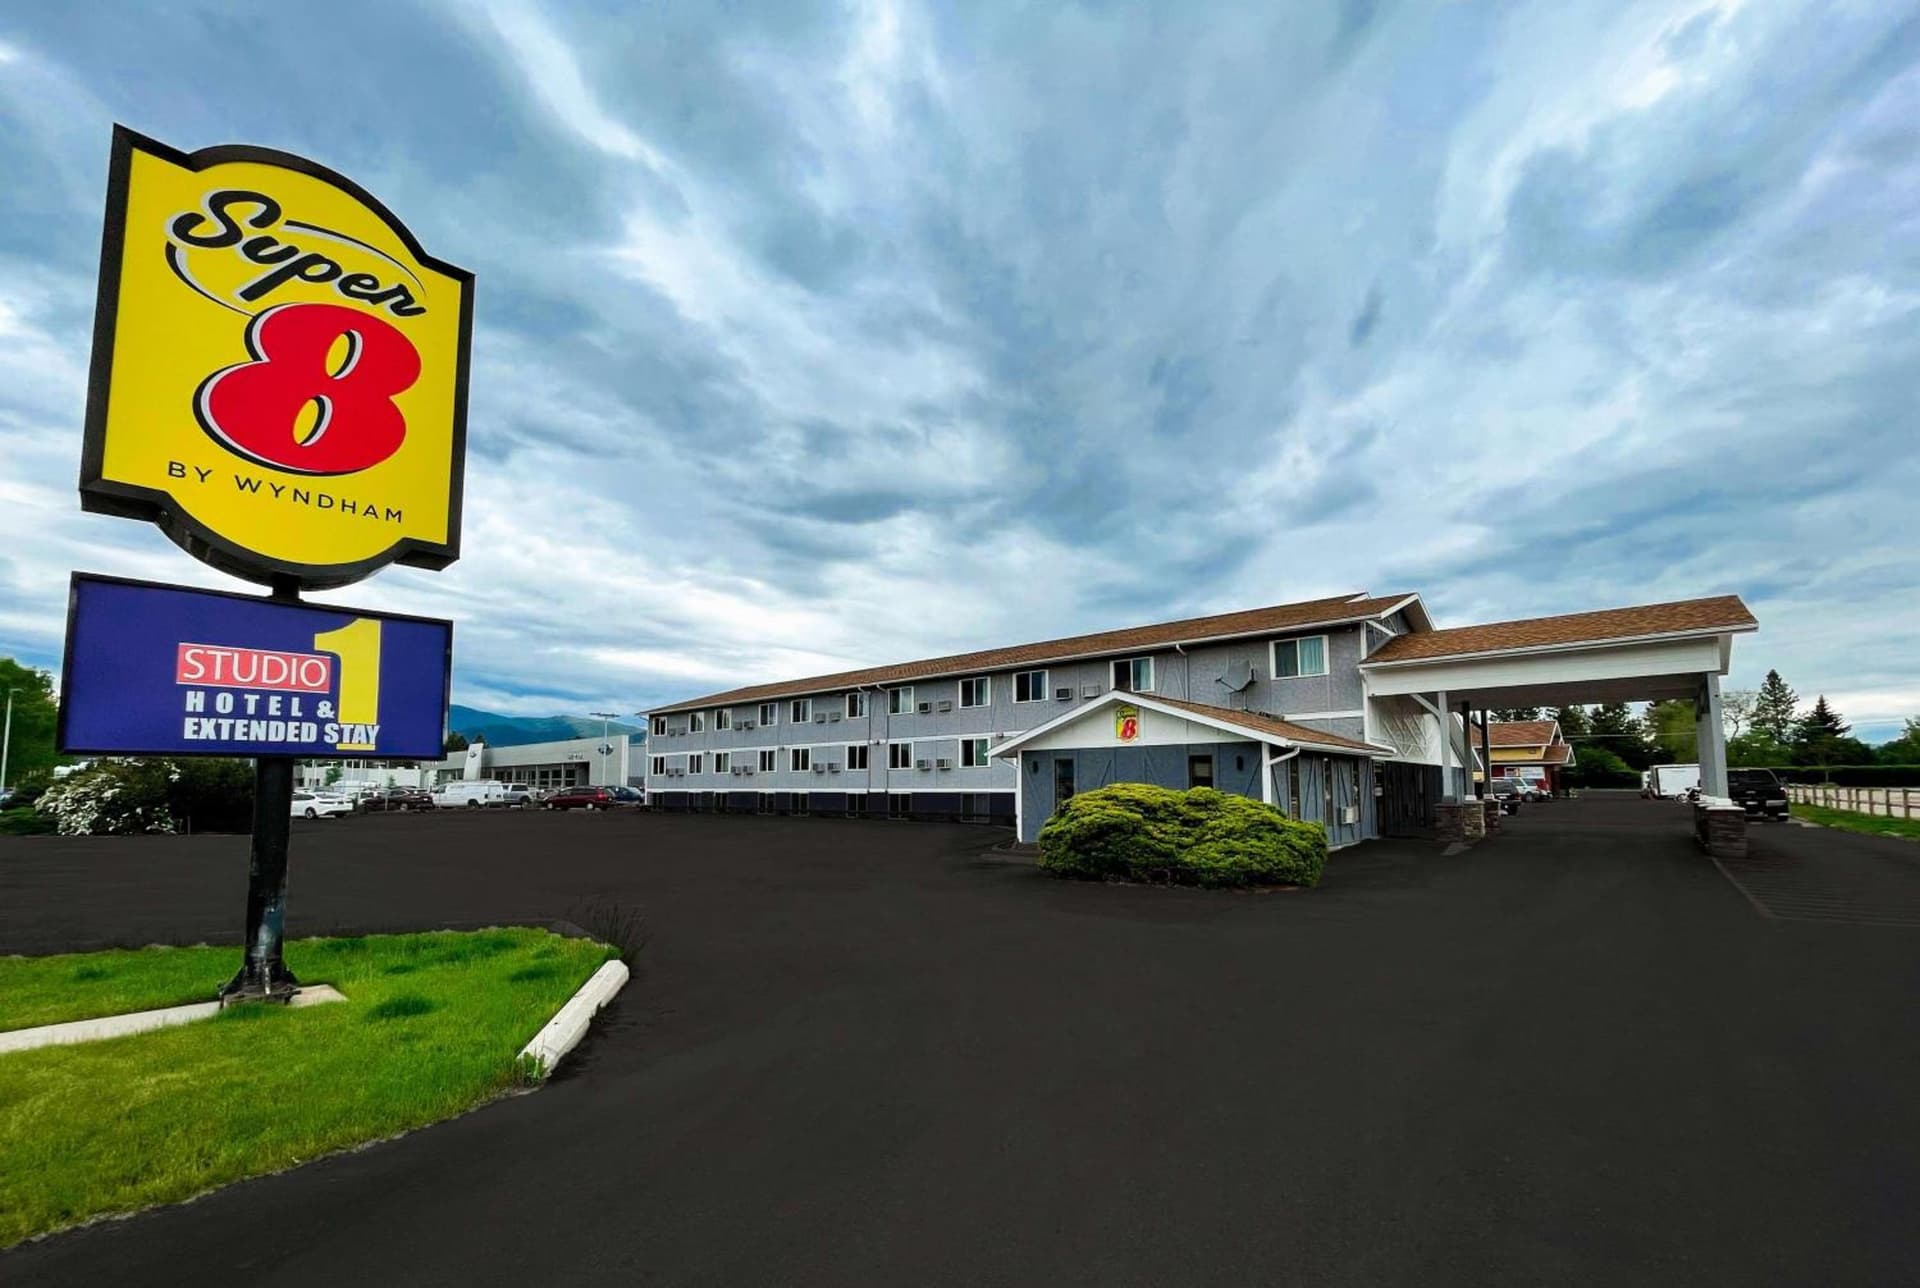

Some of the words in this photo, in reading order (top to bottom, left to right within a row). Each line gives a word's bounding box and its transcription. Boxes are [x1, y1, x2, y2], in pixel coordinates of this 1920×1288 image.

[166, 188, 427, 317] Super
[192, 302, 422, 477] 8
[168, 460, 213, 484] BY
[234, 474, 404, 524] WYNDHAM
[183, 648, 327, 687] STUDIO
[186, 691, 302, 717] HOTEL
[316, 700, 336, 719] &
[183, 718, 317, 743] EXTENDED
[324, 723, 380, 745] STAY
